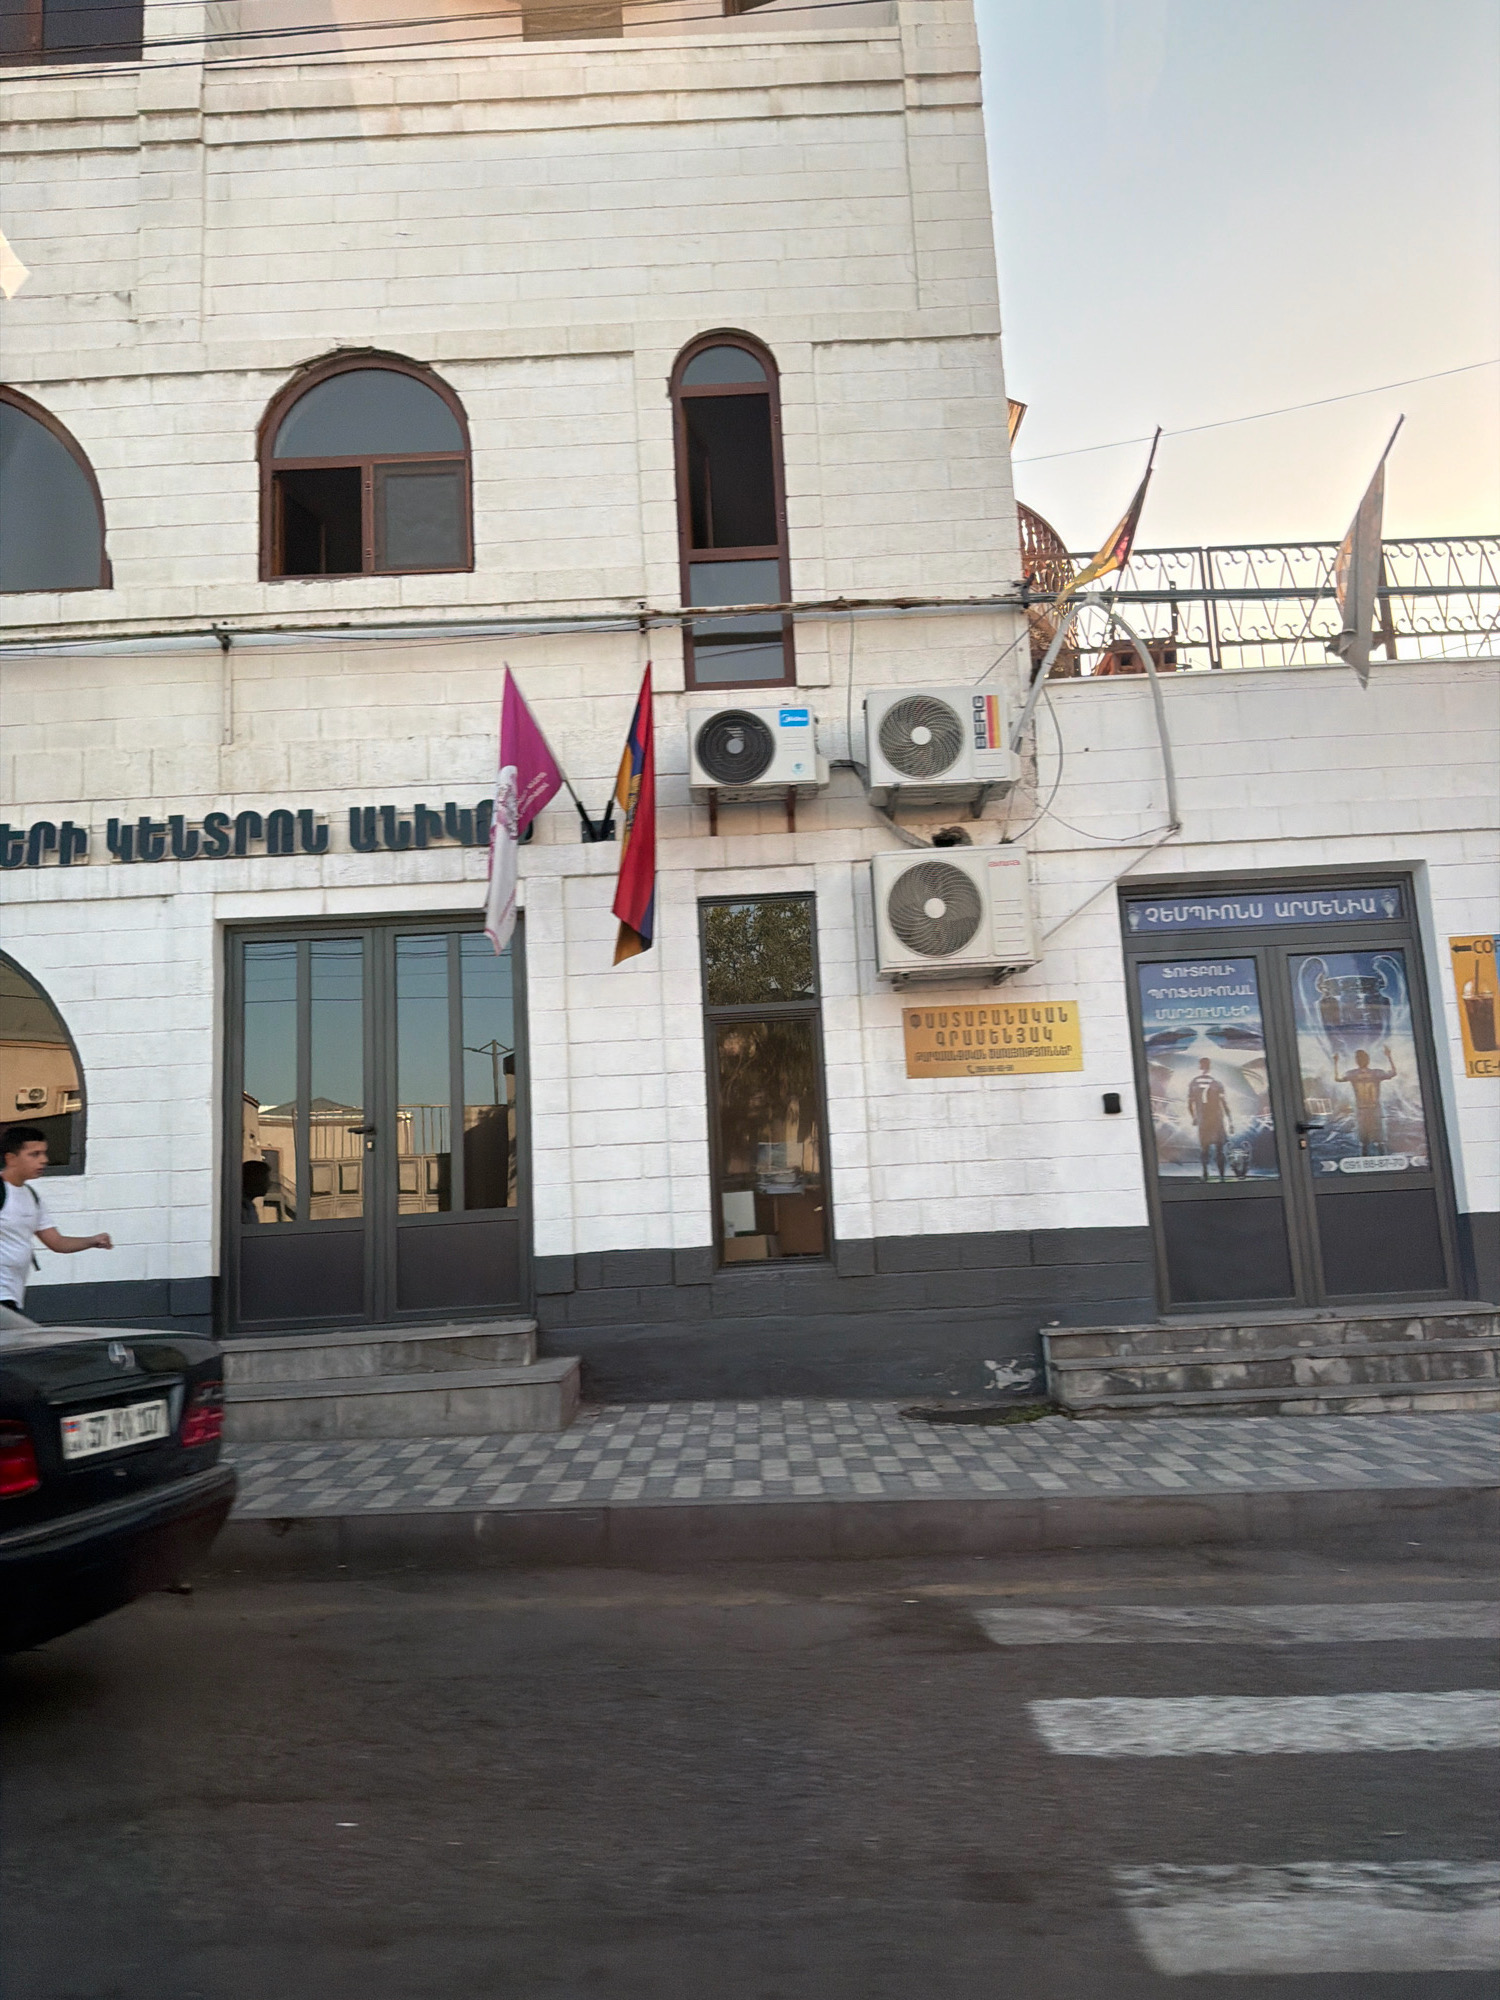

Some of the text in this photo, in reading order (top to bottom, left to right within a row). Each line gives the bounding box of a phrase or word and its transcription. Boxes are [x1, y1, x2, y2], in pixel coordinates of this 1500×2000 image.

[972, 695, 987, 750] BERG
[107, 808, 329, 863] ԿԵՆՏՐՈՆ
[1145, 898, 1377, 923] ՉԵՄՊԻՈՆՍ ԱՐՄԵՆԻԱ
[909, 1006, 1069, 1030] ՓԱՍՏԱԲԱՆԱԿԱՆ
[935, 1026, 1053, 1047] ԳՐԱՍԵՆՅԱԿ
[1469, 1058, 1500, 1075] ICE-
[1198, 1083, 1210, 1104] 7
